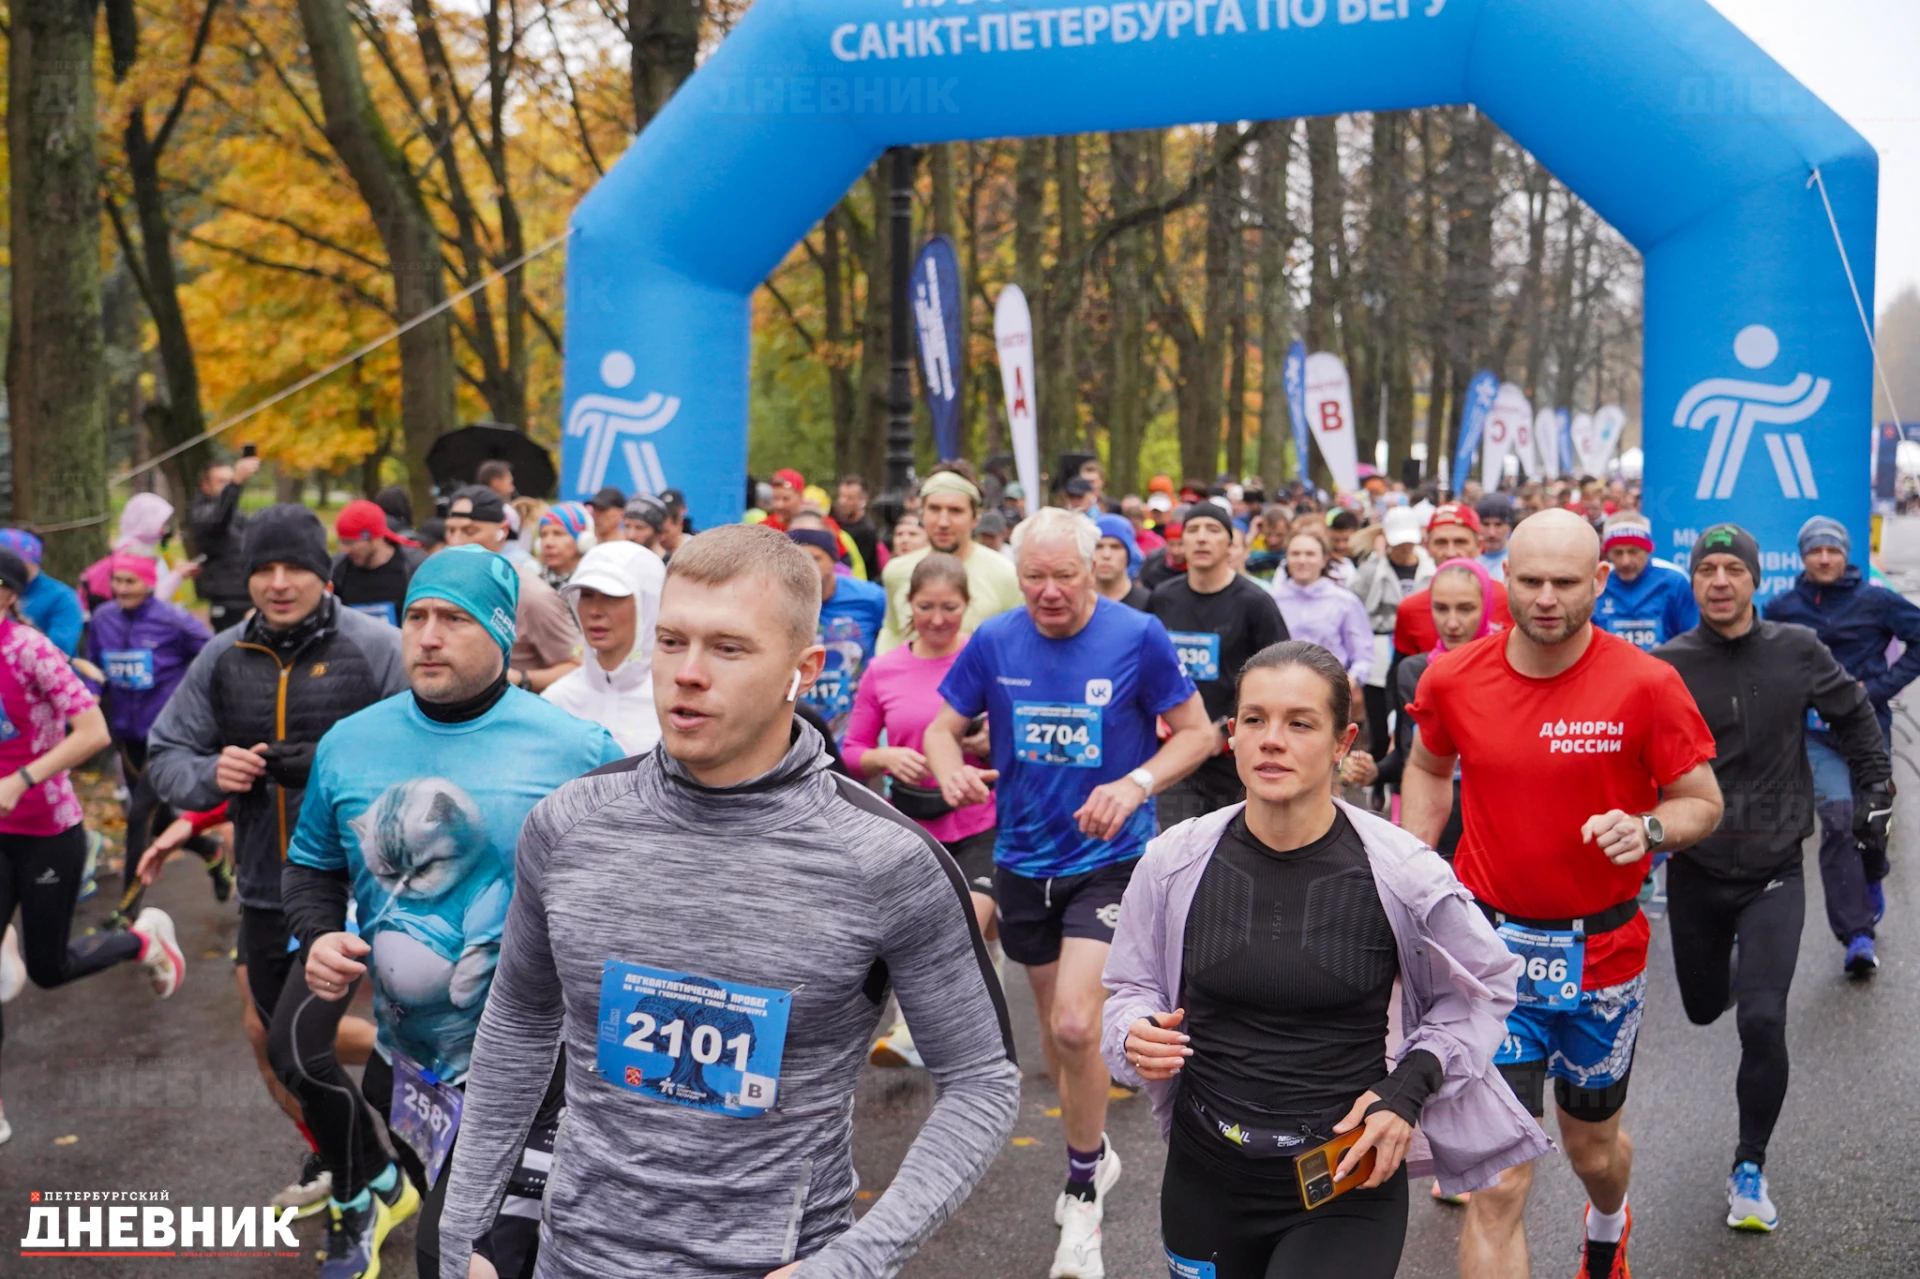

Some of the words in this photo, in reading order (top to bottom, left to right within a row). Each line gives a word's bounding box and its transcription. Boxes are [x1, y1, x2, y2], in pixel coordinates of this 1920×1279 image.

[830, 0, 1246, 61] САНКТ-ПЕТЕРБУРГА
[1254, 0, 1326, 30] ПО
[1025, 723, 1089, 745] 2704
[1550, 739, 1622, 753] РОССИИ
[624, 973, 727, 1001] ЛЕГКОАТЛЕТИЧЕСКИЙ
[731, 993, 769, 1008] ПРОБЕГ
[623, 1012, 750, 1072] 2101
[404, 1083, 453, 1141] 2587
